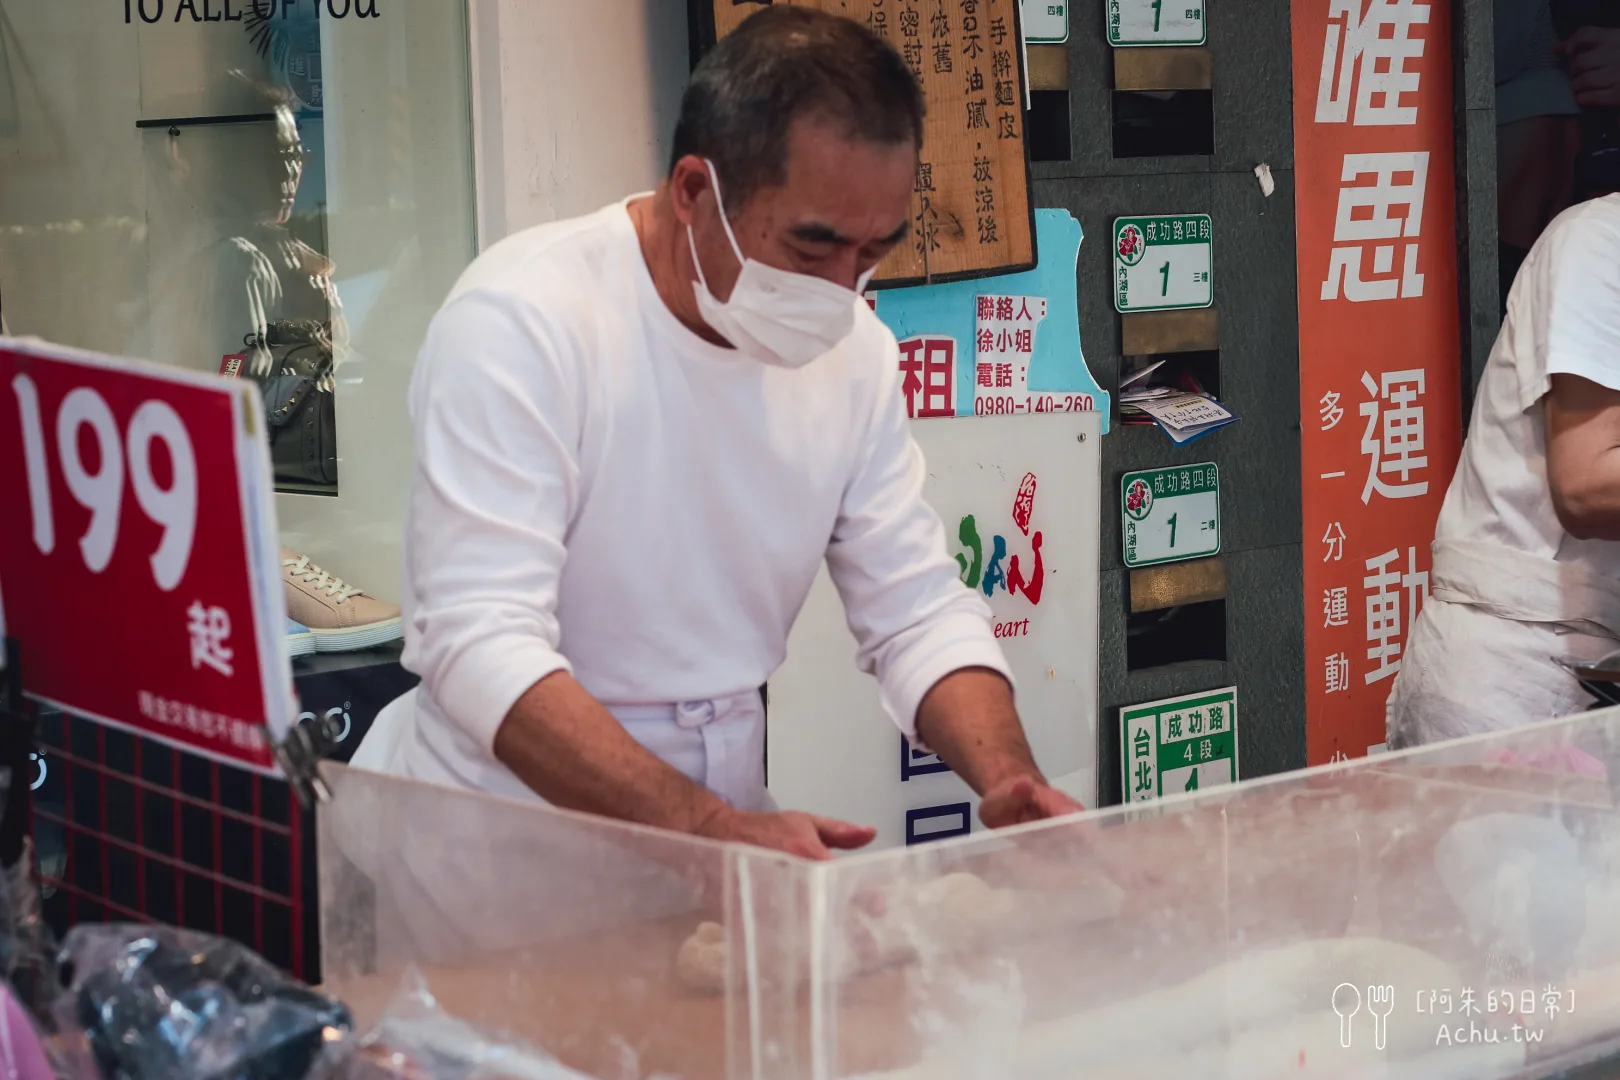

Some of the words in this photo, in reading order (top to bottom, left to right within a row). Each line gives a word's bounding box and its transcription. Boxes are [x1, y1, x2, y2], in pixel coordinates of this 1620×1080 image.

[174, 0, 242, 22] ALL
[1146, 219, 1210, 241] 成功路四段
[1159, 261, 1170, 297] 1
[976, 328, 1032, 354] 徐小姐
[12, 372, 199, 592] 199
[1154, 468, 1217, 494] 成功路四段
[1167, 512, 1178, 549] 1
[186, 599, 234, 678] 起
[993, 616, 1030, 639] eart
[1168, 705, 1224, 739] 成功路
